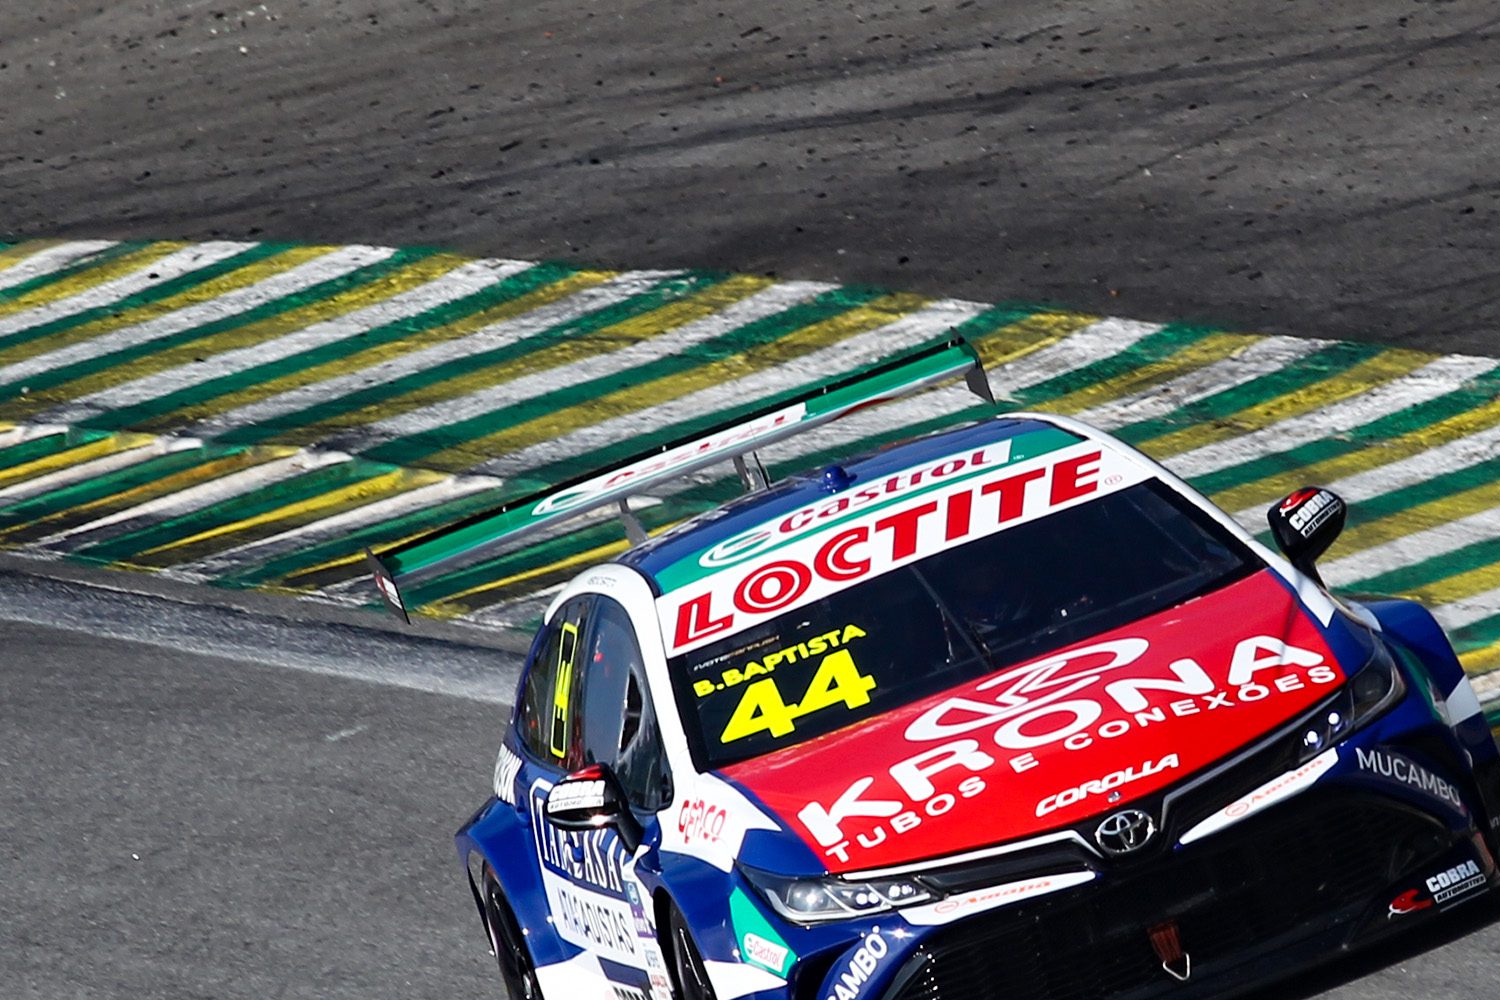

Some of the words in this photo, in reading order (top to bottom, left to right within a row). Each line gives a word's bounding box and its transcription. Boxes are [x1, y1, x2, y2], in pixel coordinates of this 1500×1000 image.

[779, 450, 991, 536] Castrol
[1289, 490, 1334, 531] COBRA
[672, 450, 1102, 650] LOCTITE
[693, 624, 867, 698] B.BAPTISTA
[720, 648, 877, 744] 44
[797, 635, 1325, 847] KRONA
[825, 775, 987, 864] TUBOS
[1008, 751, 1040, 774] E
[1063, 664, 1338, 750] CONEXÕES
[1355, 747, 1462, 807] MUCAMBO
[1035, 753, 1179, 818] COROLLA
[1425, 859, 1481, 893] COBRA
